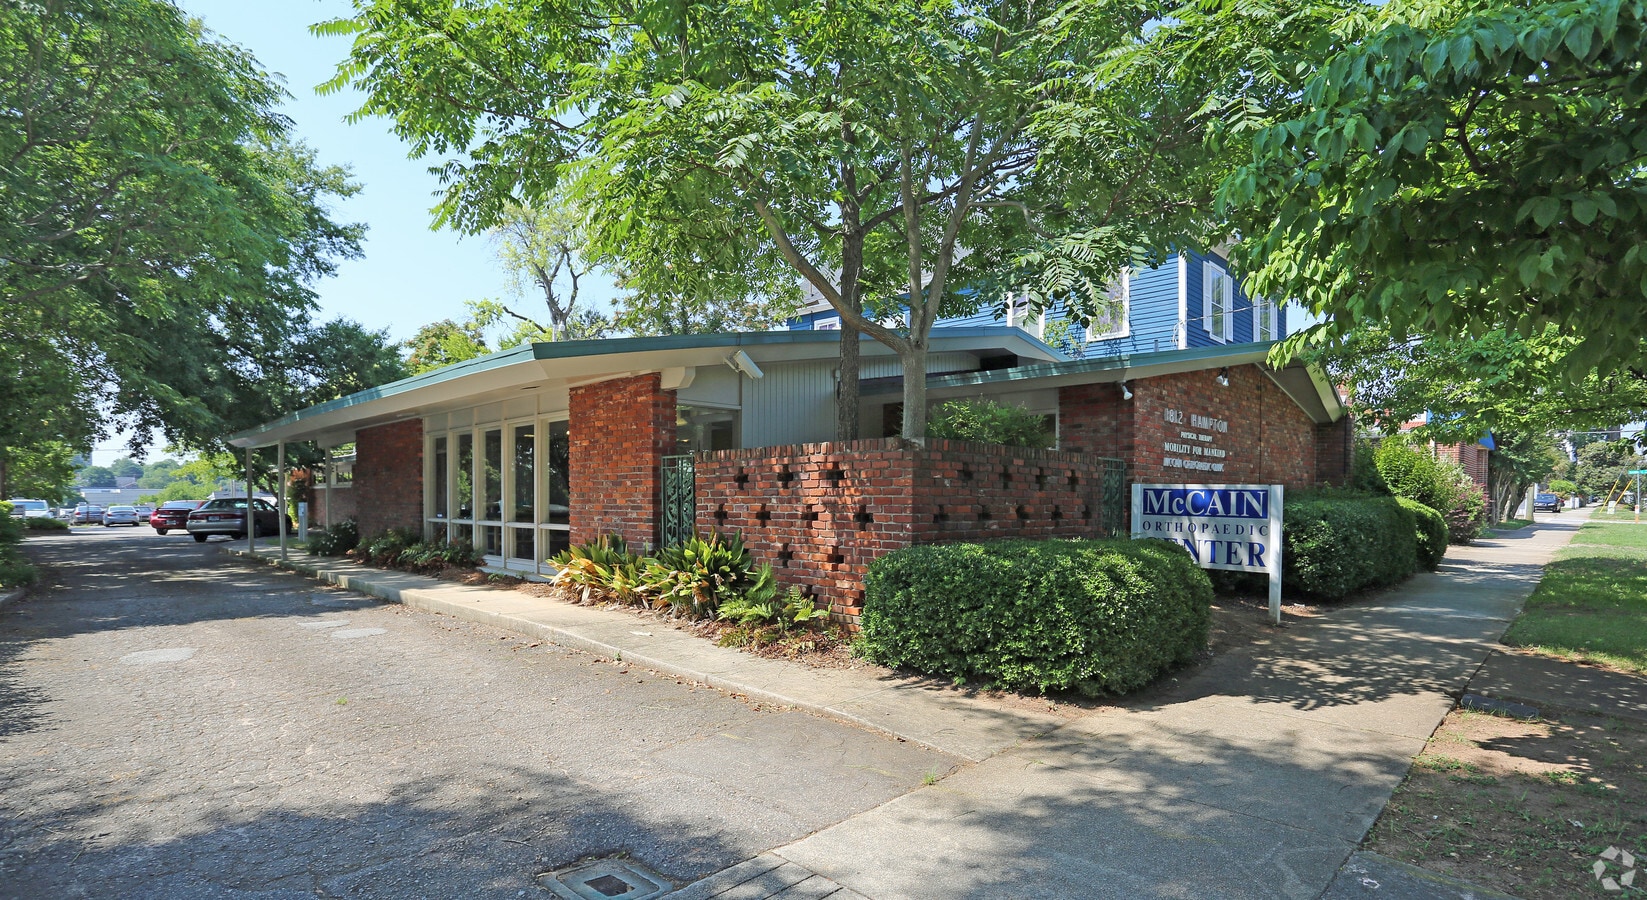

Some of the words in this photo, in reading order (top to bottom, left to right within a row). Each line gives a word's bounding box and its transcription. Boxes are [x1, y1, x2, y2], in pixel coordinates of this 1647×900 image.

[1191, 414, 1229, 433] HAMPTON
[1164, 442, 1191, 454] MOBILITY
[1192, 446, 1202, 455] FOR
[1145, 490, 1267, 517] McCAIN
[1142, 520, 1269, 536] ORTHOPAEDIC
[1148, 537, 1267, 567] NTER
